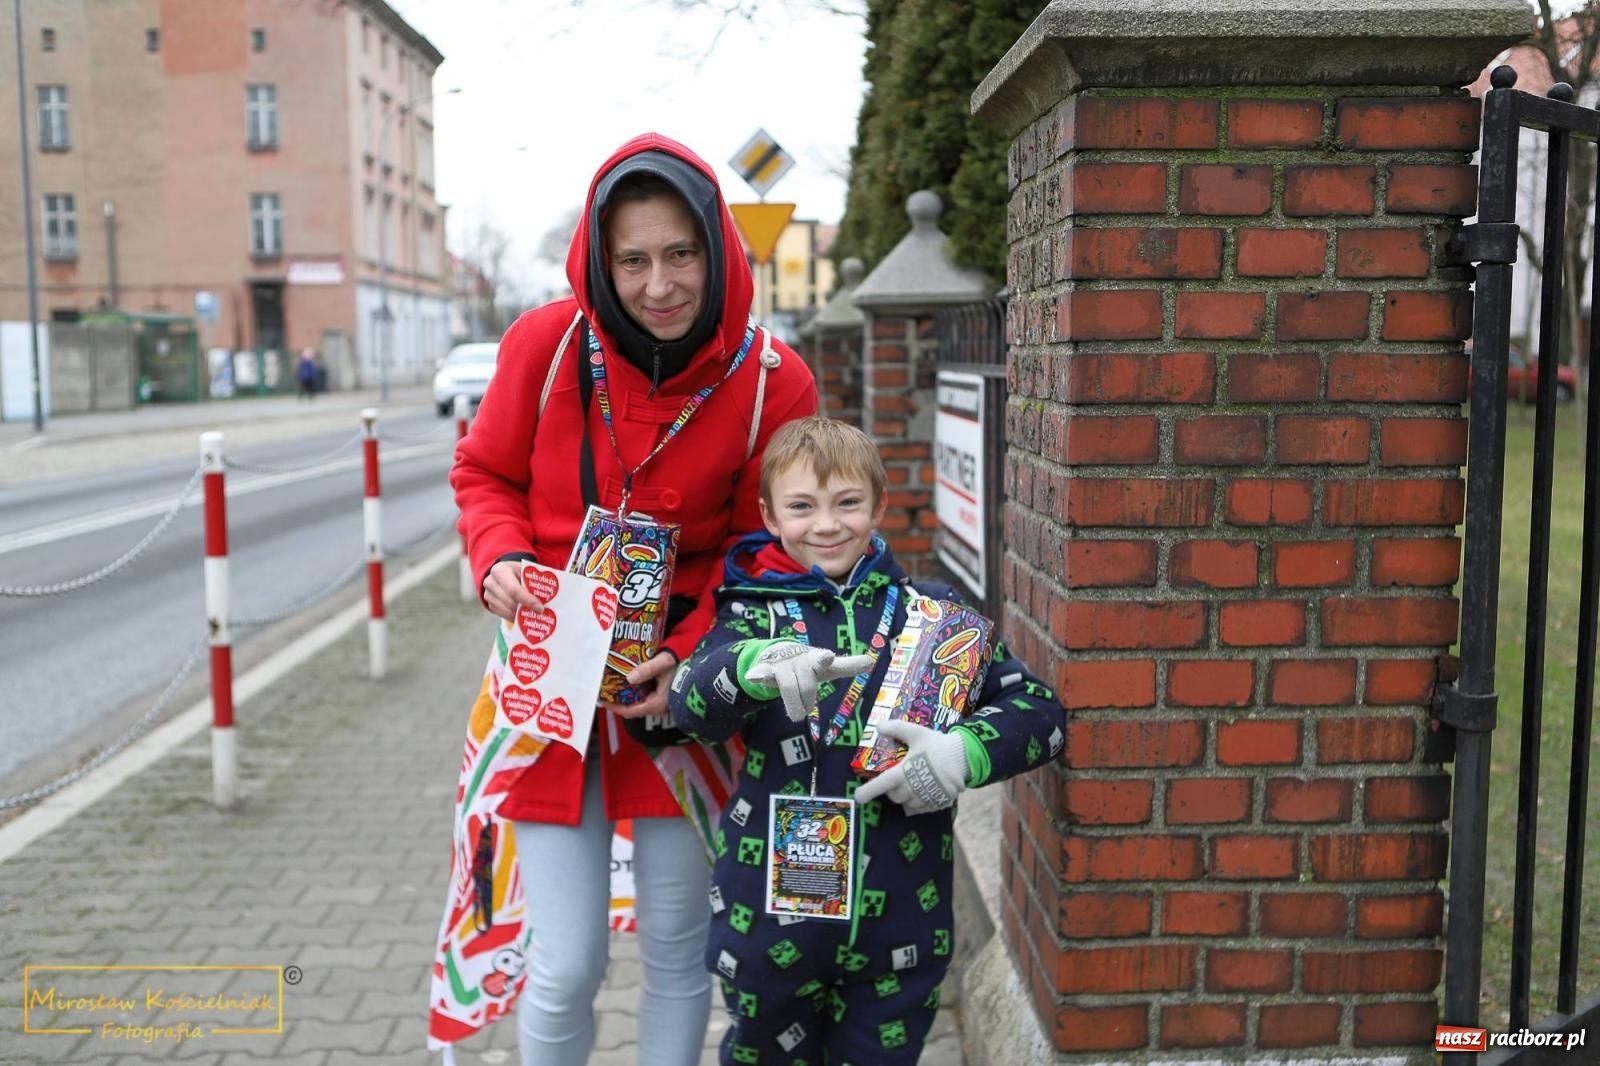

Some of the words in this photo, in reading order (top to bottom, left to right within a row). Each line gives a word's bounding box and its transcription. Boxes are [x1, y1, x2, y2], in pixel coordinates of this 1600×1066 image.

[614, 620, 640, 640] YSTKO
[641, 622, 653, 641] GR
[797, 821, 822, 839] 32
[787, 843, 836, 857] PŁUCA
[787, 854, 798, 862] PO
